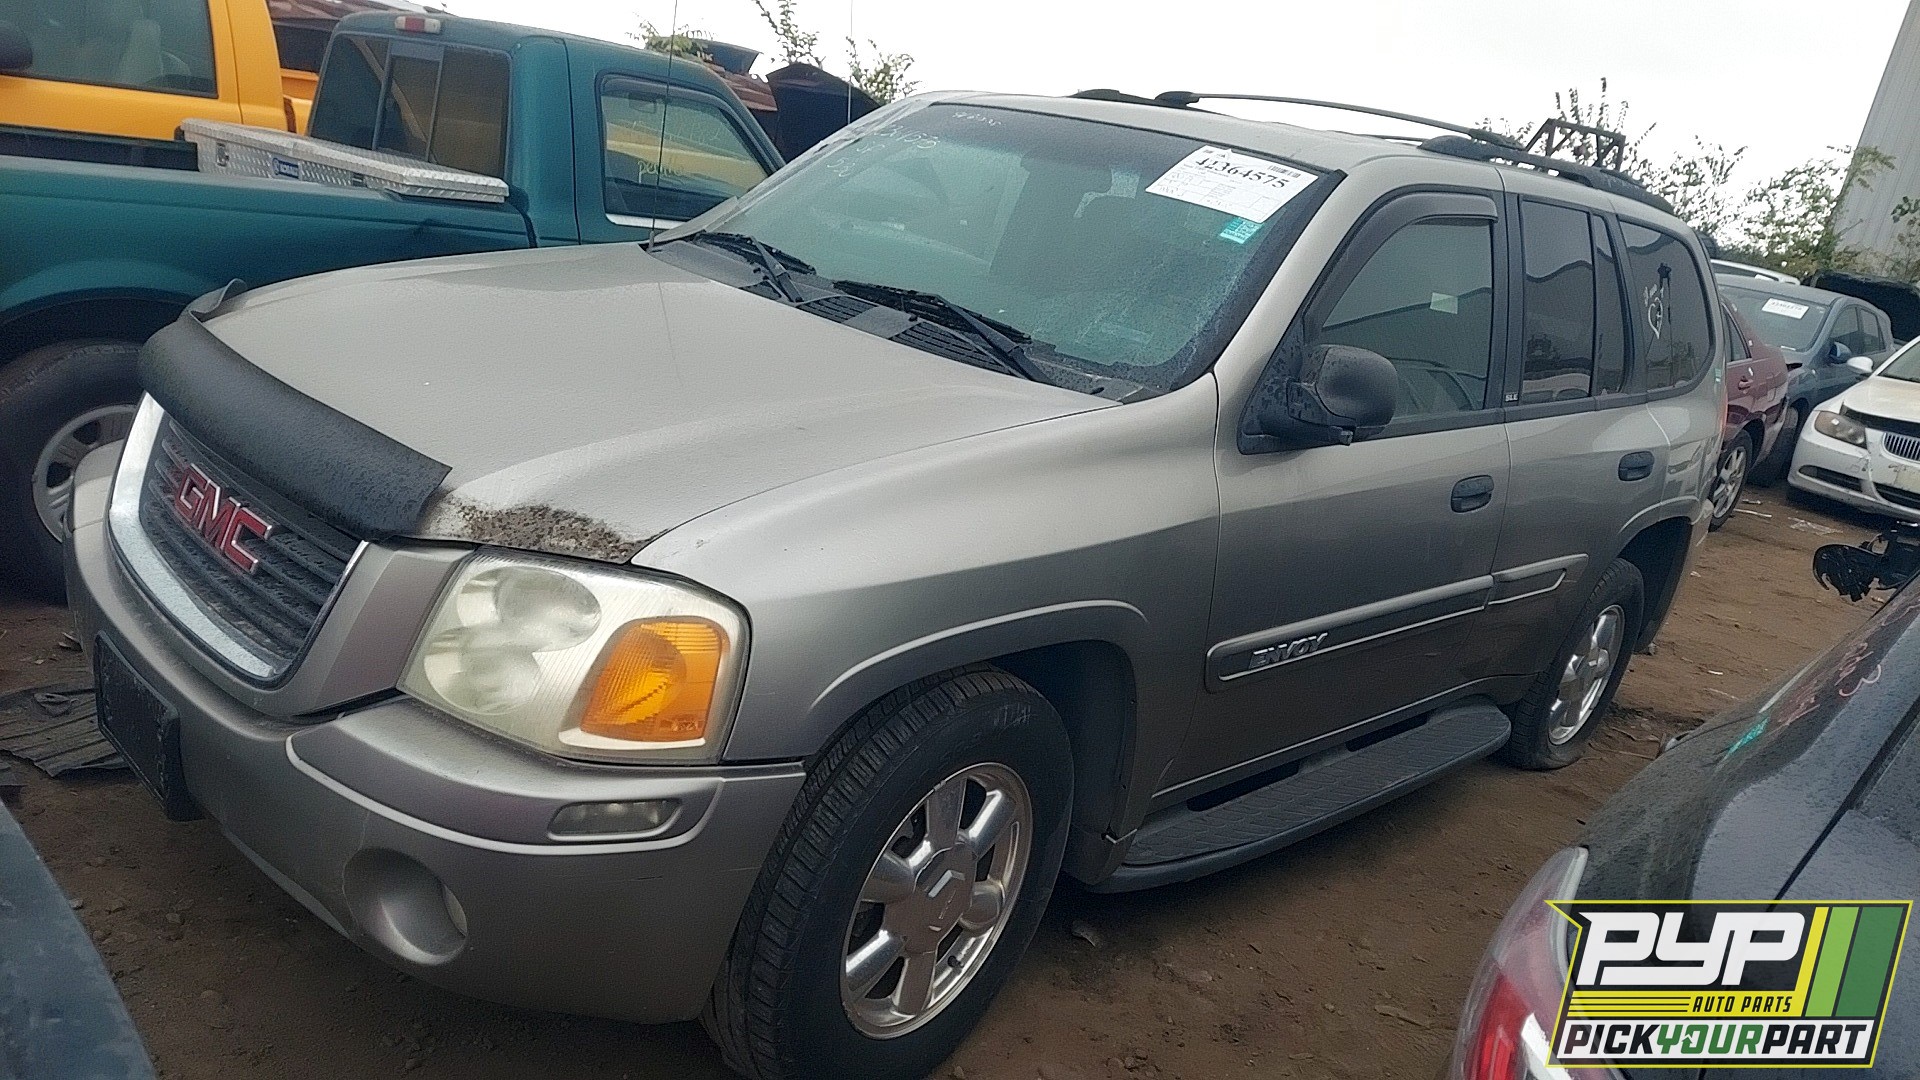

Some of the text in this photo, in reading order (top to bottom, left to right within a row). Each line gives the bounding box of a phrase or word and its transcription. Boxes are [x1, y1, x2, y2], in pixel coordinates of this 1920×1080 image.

[1196, 157, 1290, 188] 42364575
[174, 462, 273, 576] GMC
[1247, 632, 1328, 670] ENVOY
